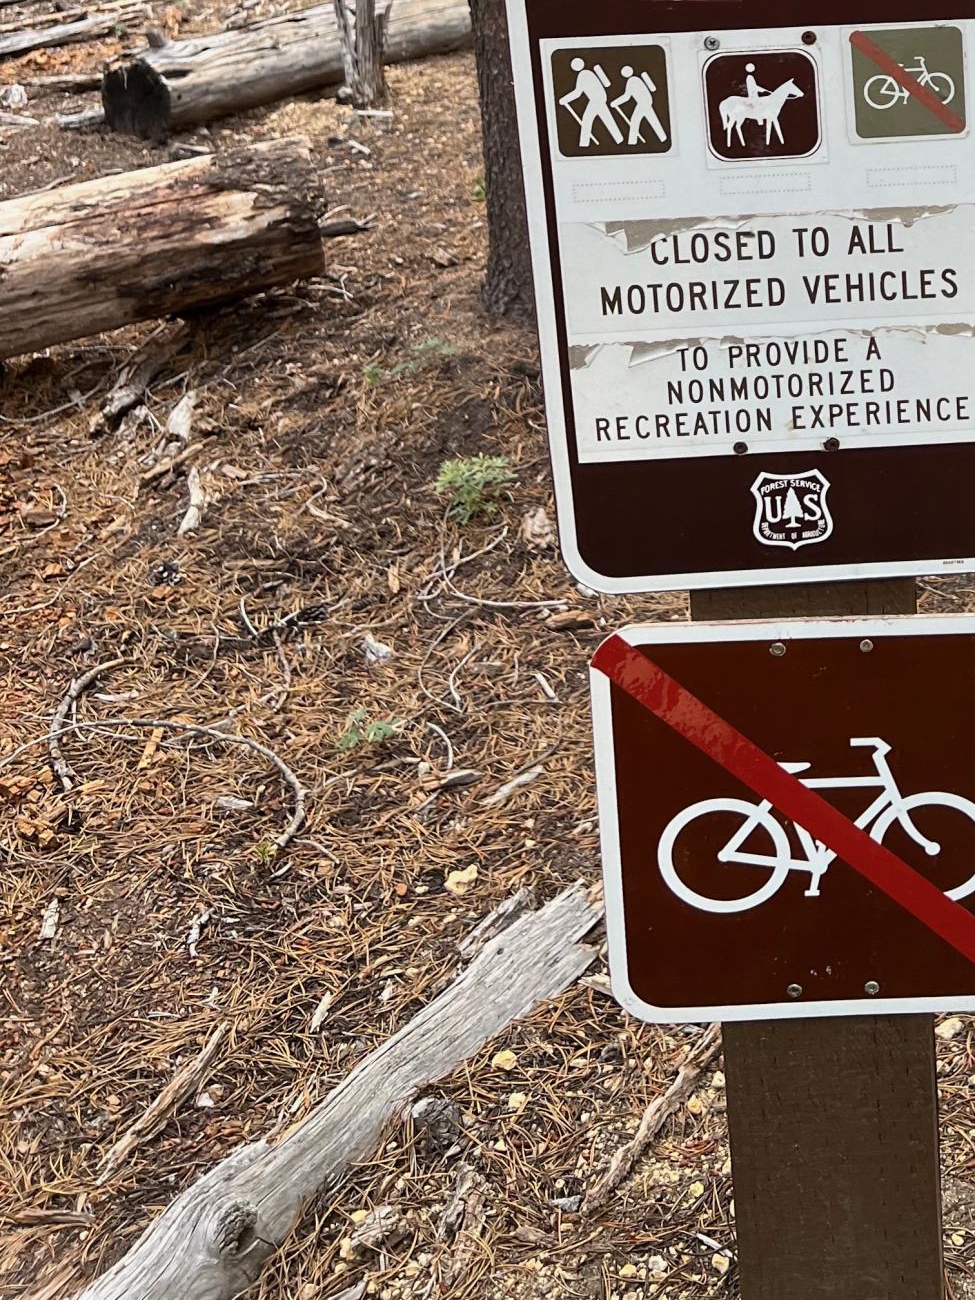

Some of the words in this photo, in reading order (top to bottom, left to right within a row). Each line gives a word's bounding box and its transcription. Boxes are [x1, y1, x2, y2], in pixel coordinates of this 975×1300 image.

[650, 230, 776, 266] CLOSED
[792, 226, 829, 258] TO
[847, 223, 904, 255] ALL
[600, 277, 786, 316] MOTORIZED
[802, 268, 958, 305] VEHICLES
[676, 346, 708, 372] TO
[728, 338, 849, 369] PROVIDE
[866, 336, 882, 361] A
[667, 368, 895, 405] NONMOTORIZED
[595, 407, 772, 442] RECREATION
[791, 396, 970, 431] EXPERIENCE
[761, 480, 788, 496] FOREST
[790, 479, 821, 493] SERVICE
[763, 496, 782, 523] U
[803, 494, 822, 521] S
